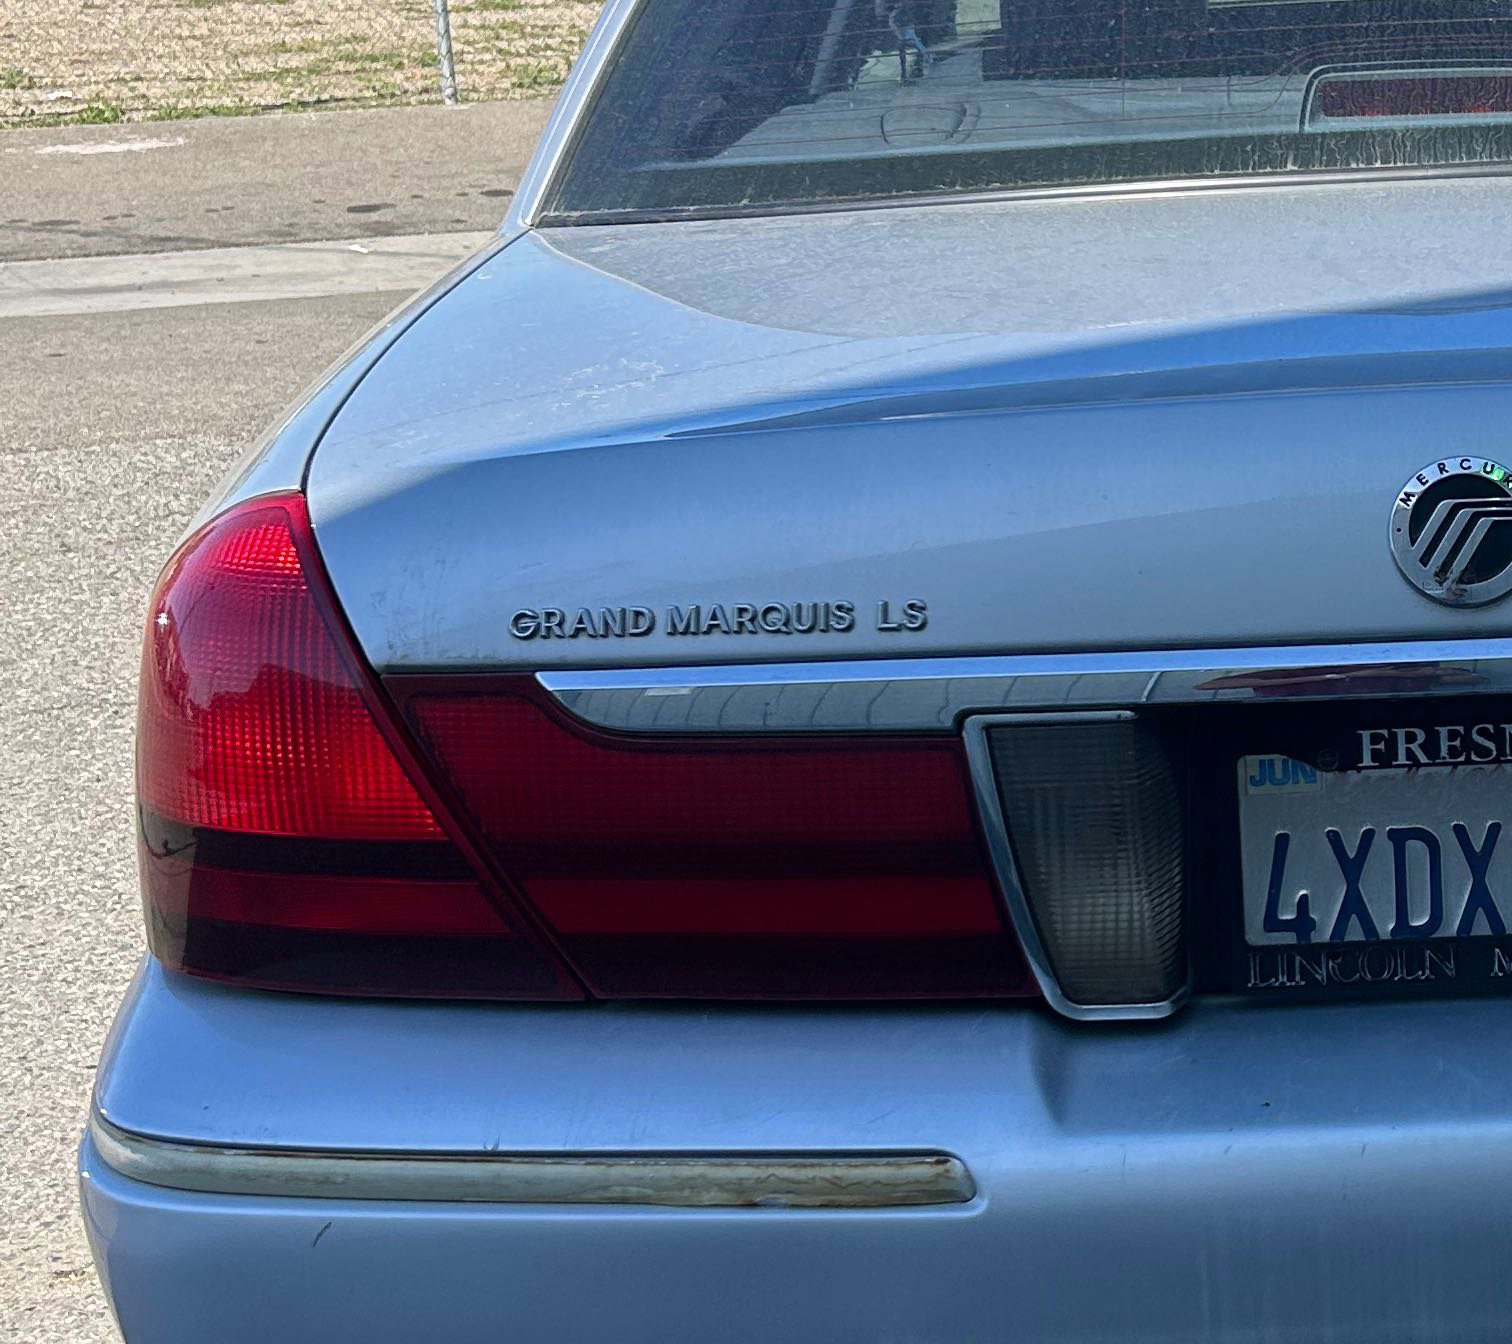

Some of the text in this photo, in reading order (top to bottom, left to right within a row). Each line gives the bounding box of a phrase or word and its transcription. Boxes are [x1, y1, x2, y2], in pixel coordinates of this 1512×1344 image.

[508, 598, 929, 640] GRAND MARQUIS LS
[1249, 758, 1318, 787] JUN
[1247, 941, 1457, 989] LINCOLN
